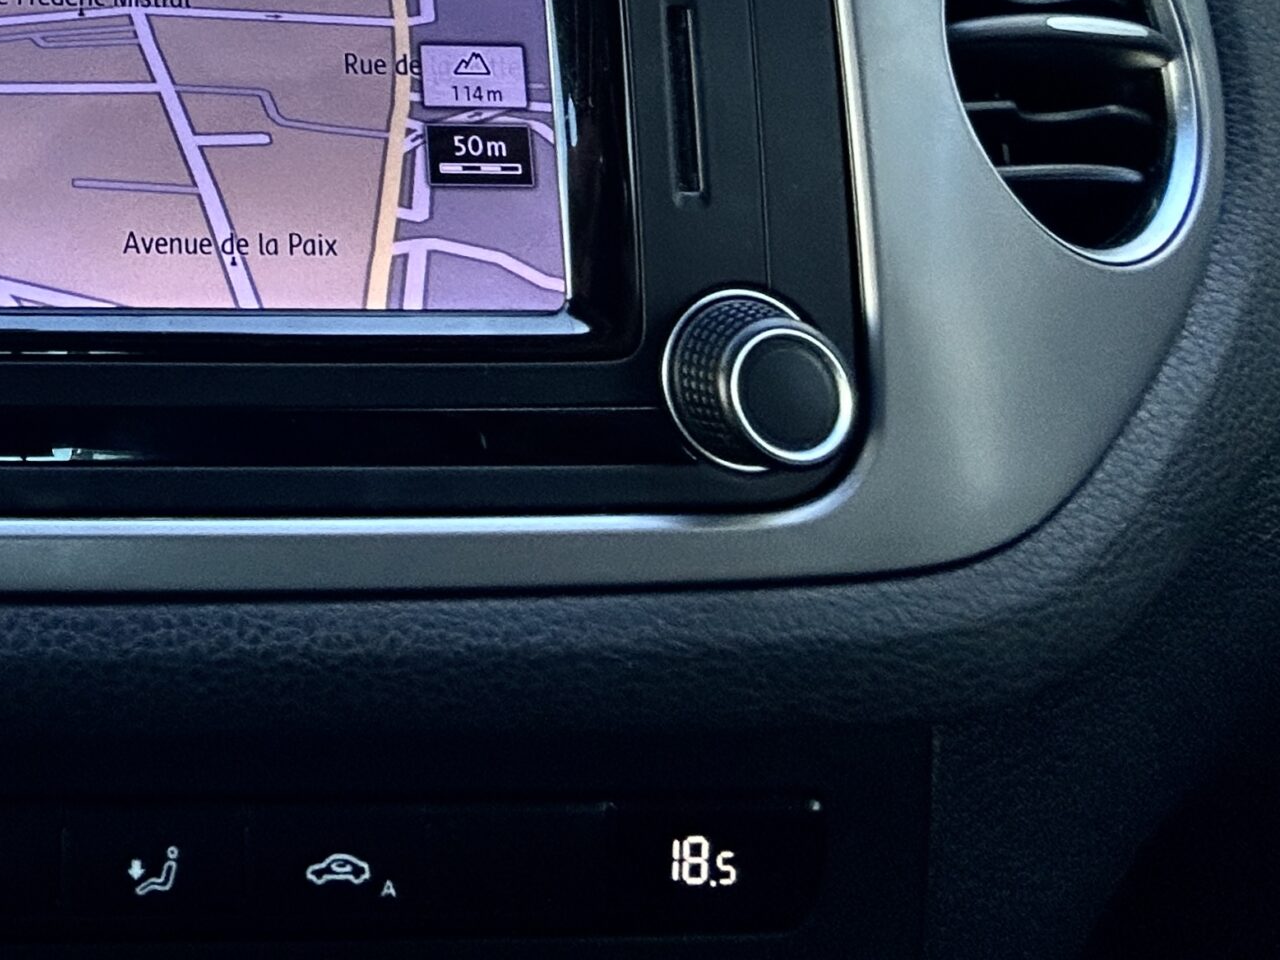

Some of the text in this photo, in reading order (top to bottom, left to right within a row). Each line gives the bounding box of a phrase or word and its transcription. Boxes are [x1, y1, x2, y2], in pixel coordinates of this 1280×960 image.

[344, 52, 387, 75] Rue
[122, 231, 338, 257] Avenue de la Paix
[672, 835, 737, 888] 18.5
[381, 880, 397, 897] A
